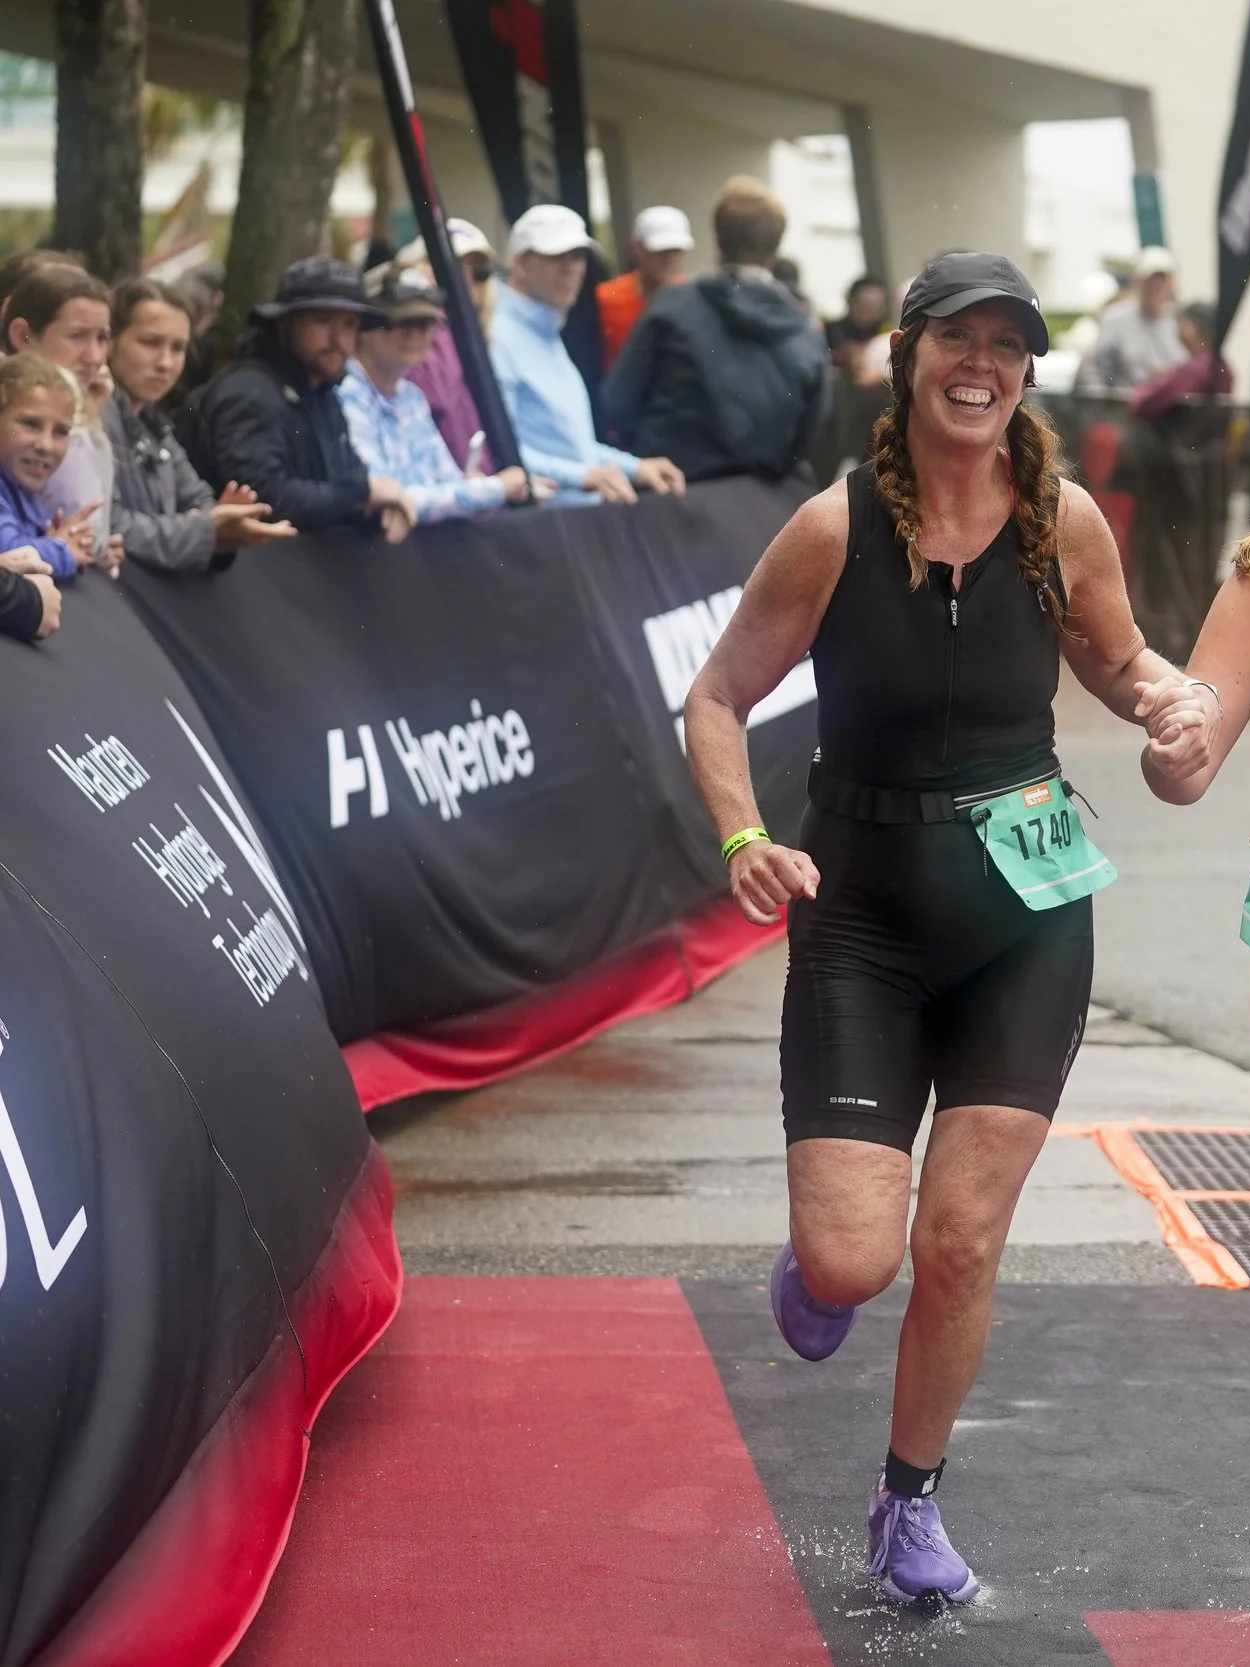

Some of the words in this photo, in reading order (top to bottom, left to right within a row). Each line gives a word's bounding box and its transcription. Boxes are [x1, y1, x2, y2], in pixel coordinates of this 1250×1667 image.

[47, 732, 151, 813] Maurten
[384, 698, 535, 822] Hyperice
[132, 802, 234, 919] Hydrogel
[1010, 809, 1071, 861] 1740
[211, 900, 309, 1007] Technology
